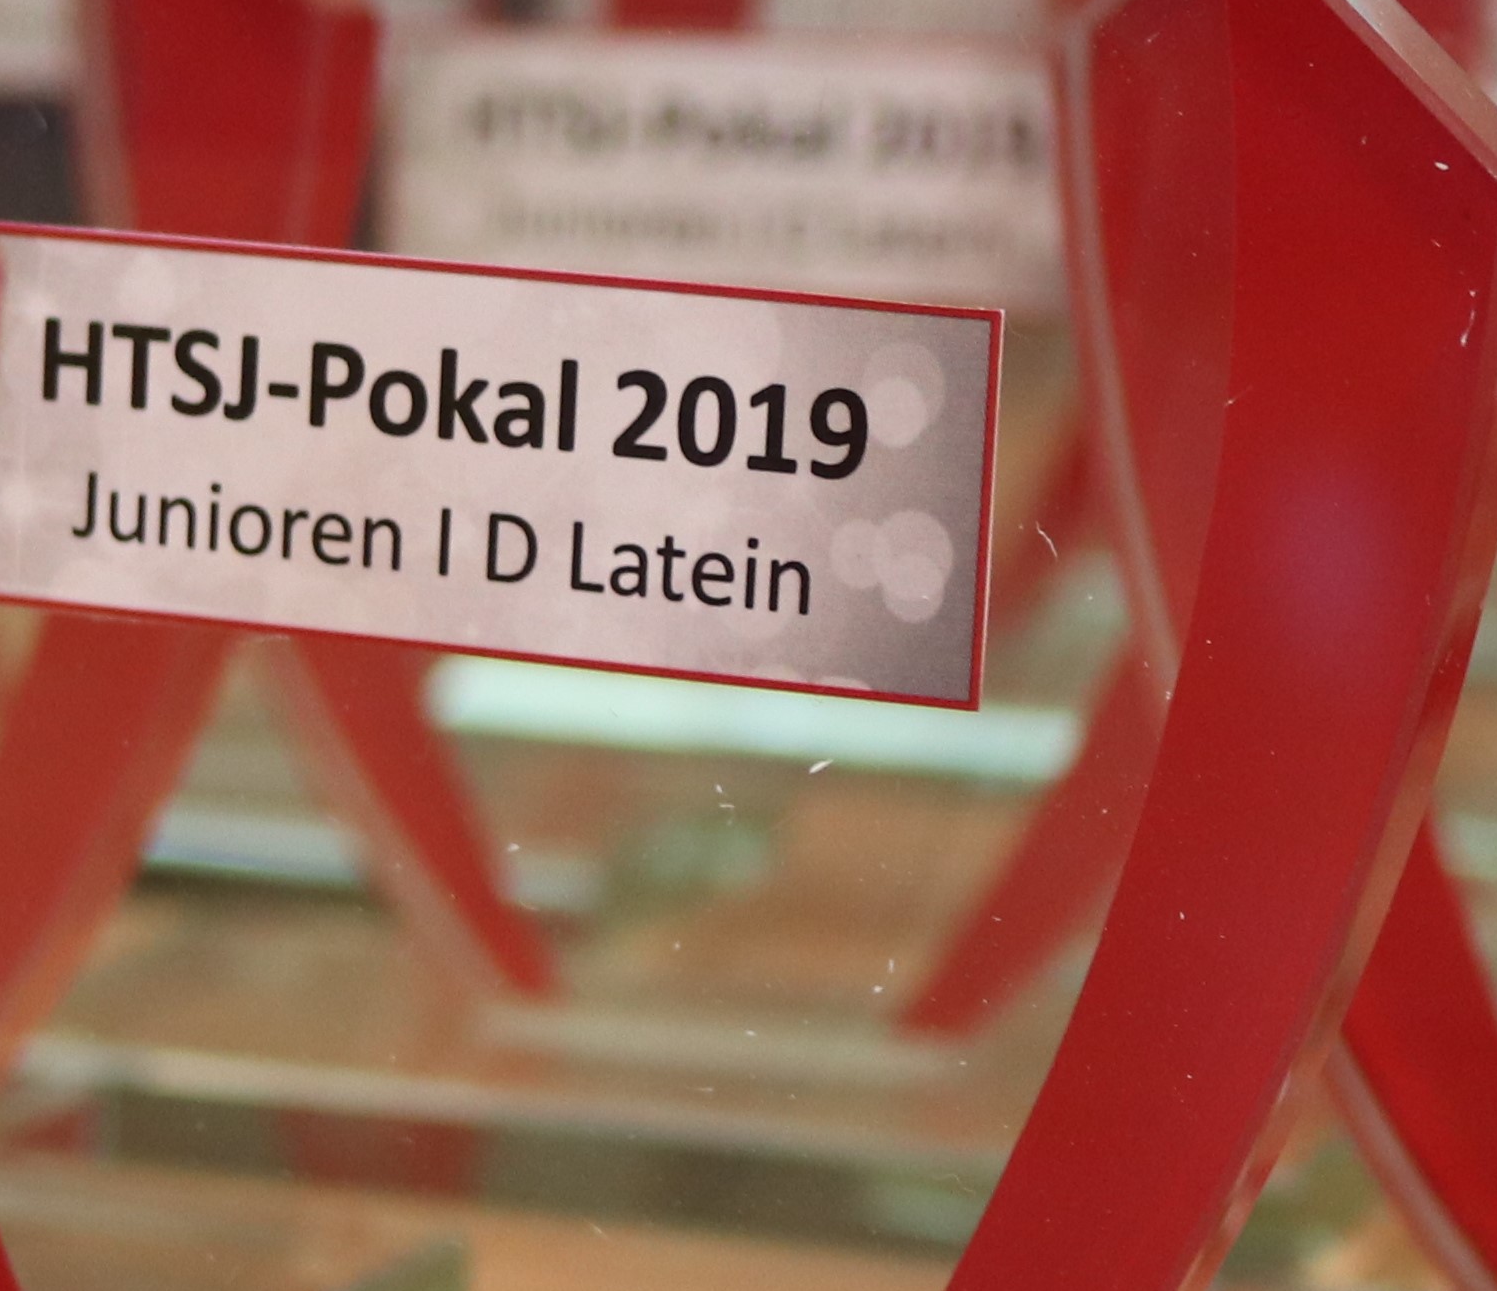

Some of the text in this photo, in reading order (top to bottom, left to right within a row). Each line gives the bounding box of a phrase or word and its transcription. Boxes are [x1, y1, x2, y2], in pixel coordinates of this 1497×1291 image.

[40, 314, 870, 483] HTSJ-Pokal 2019
[68, 468, 405, 574] Junioren
[483, 510, 540, 587] D
[567, 519, 813, 618] Latein
